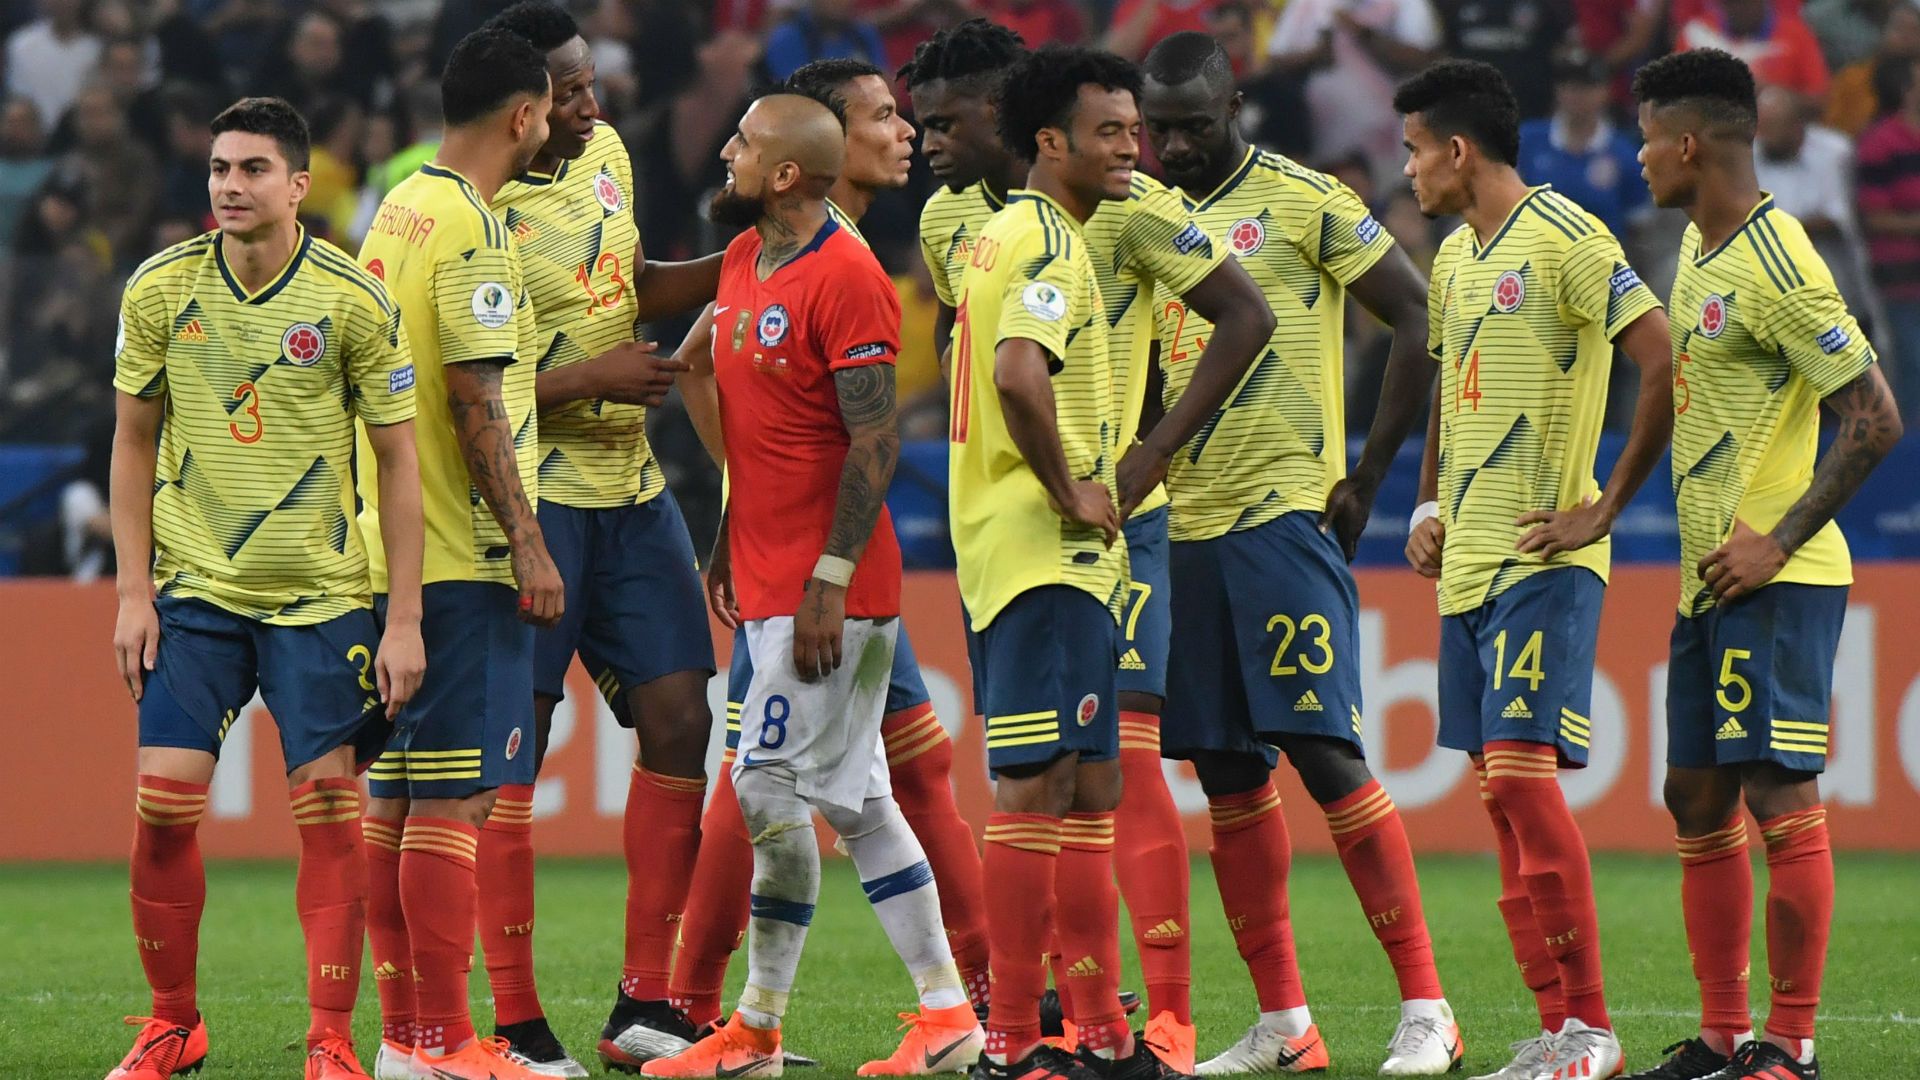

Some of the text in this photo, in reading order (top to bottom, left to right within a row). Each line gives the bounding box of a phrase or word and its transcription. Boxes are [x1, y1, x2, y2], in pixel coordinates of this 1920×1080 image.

[575, 252, 627, 316] 13
[1611, 271, 1631, 286] Cree
[176, 331, 208, 342] adidas
[1164, 301, 1215, 363] 2
[1817, 331, 1837, 346] Cree
[391, 371, 407, 383] Cree
[391, 375, 413, 391] grande
[1454, 350, 1482, 414] 14
[1673, 353, 1692, 416] 5
[229, 381, 264, 445] 3
[1125, 581, 1152, 642] 7
[1266, 613, 1334, 677] 23
[1493, 629, 1545, 692] 14
[1715, 648, 1752, 713] 5
[1293, 702, 1323, 712] adidas
[1501, 709, 1533, 719] adidas
[758, 694, 790, 750] 8
[1715, 729, 1748, 740] adidas
[504, 919, 534, 936] FCF
[1371, 906, 1401, 929] FCF
[1545, 927, 1578, 947] FCF
[320, 963, 351, 980] FCF
